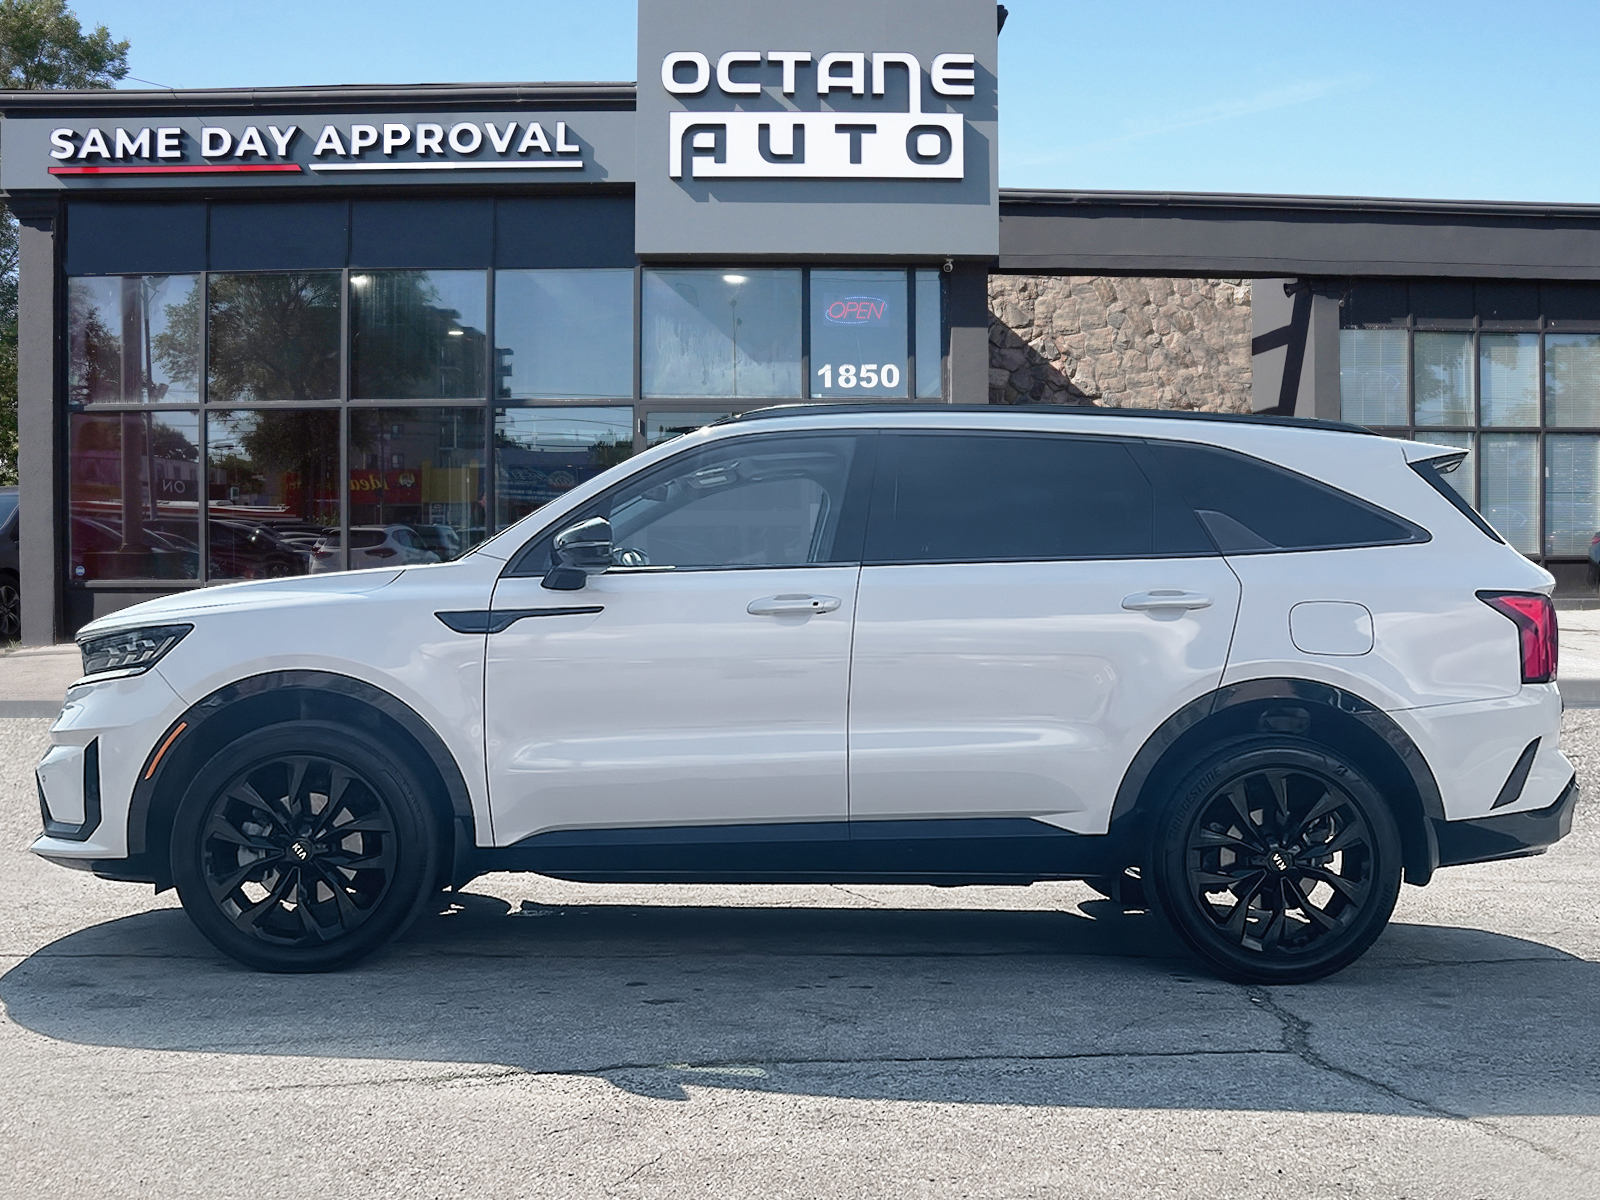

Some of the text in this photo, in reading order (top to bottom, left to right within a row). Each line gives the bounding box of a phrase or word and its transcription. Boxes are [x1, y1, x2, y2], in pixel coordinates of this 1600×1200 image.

[661, 51, 975, 112] OCTANE
[49, 120, 580, 160] SAME DAY APPROVAL
[681, 123, 953, 178] AUTO
[829, 301, 886, 320] OPEN
[817, 363, 900, 389] 1850
[291, 842, 308, 860] KIA
[1271, 853, 1287, 871] KIA
